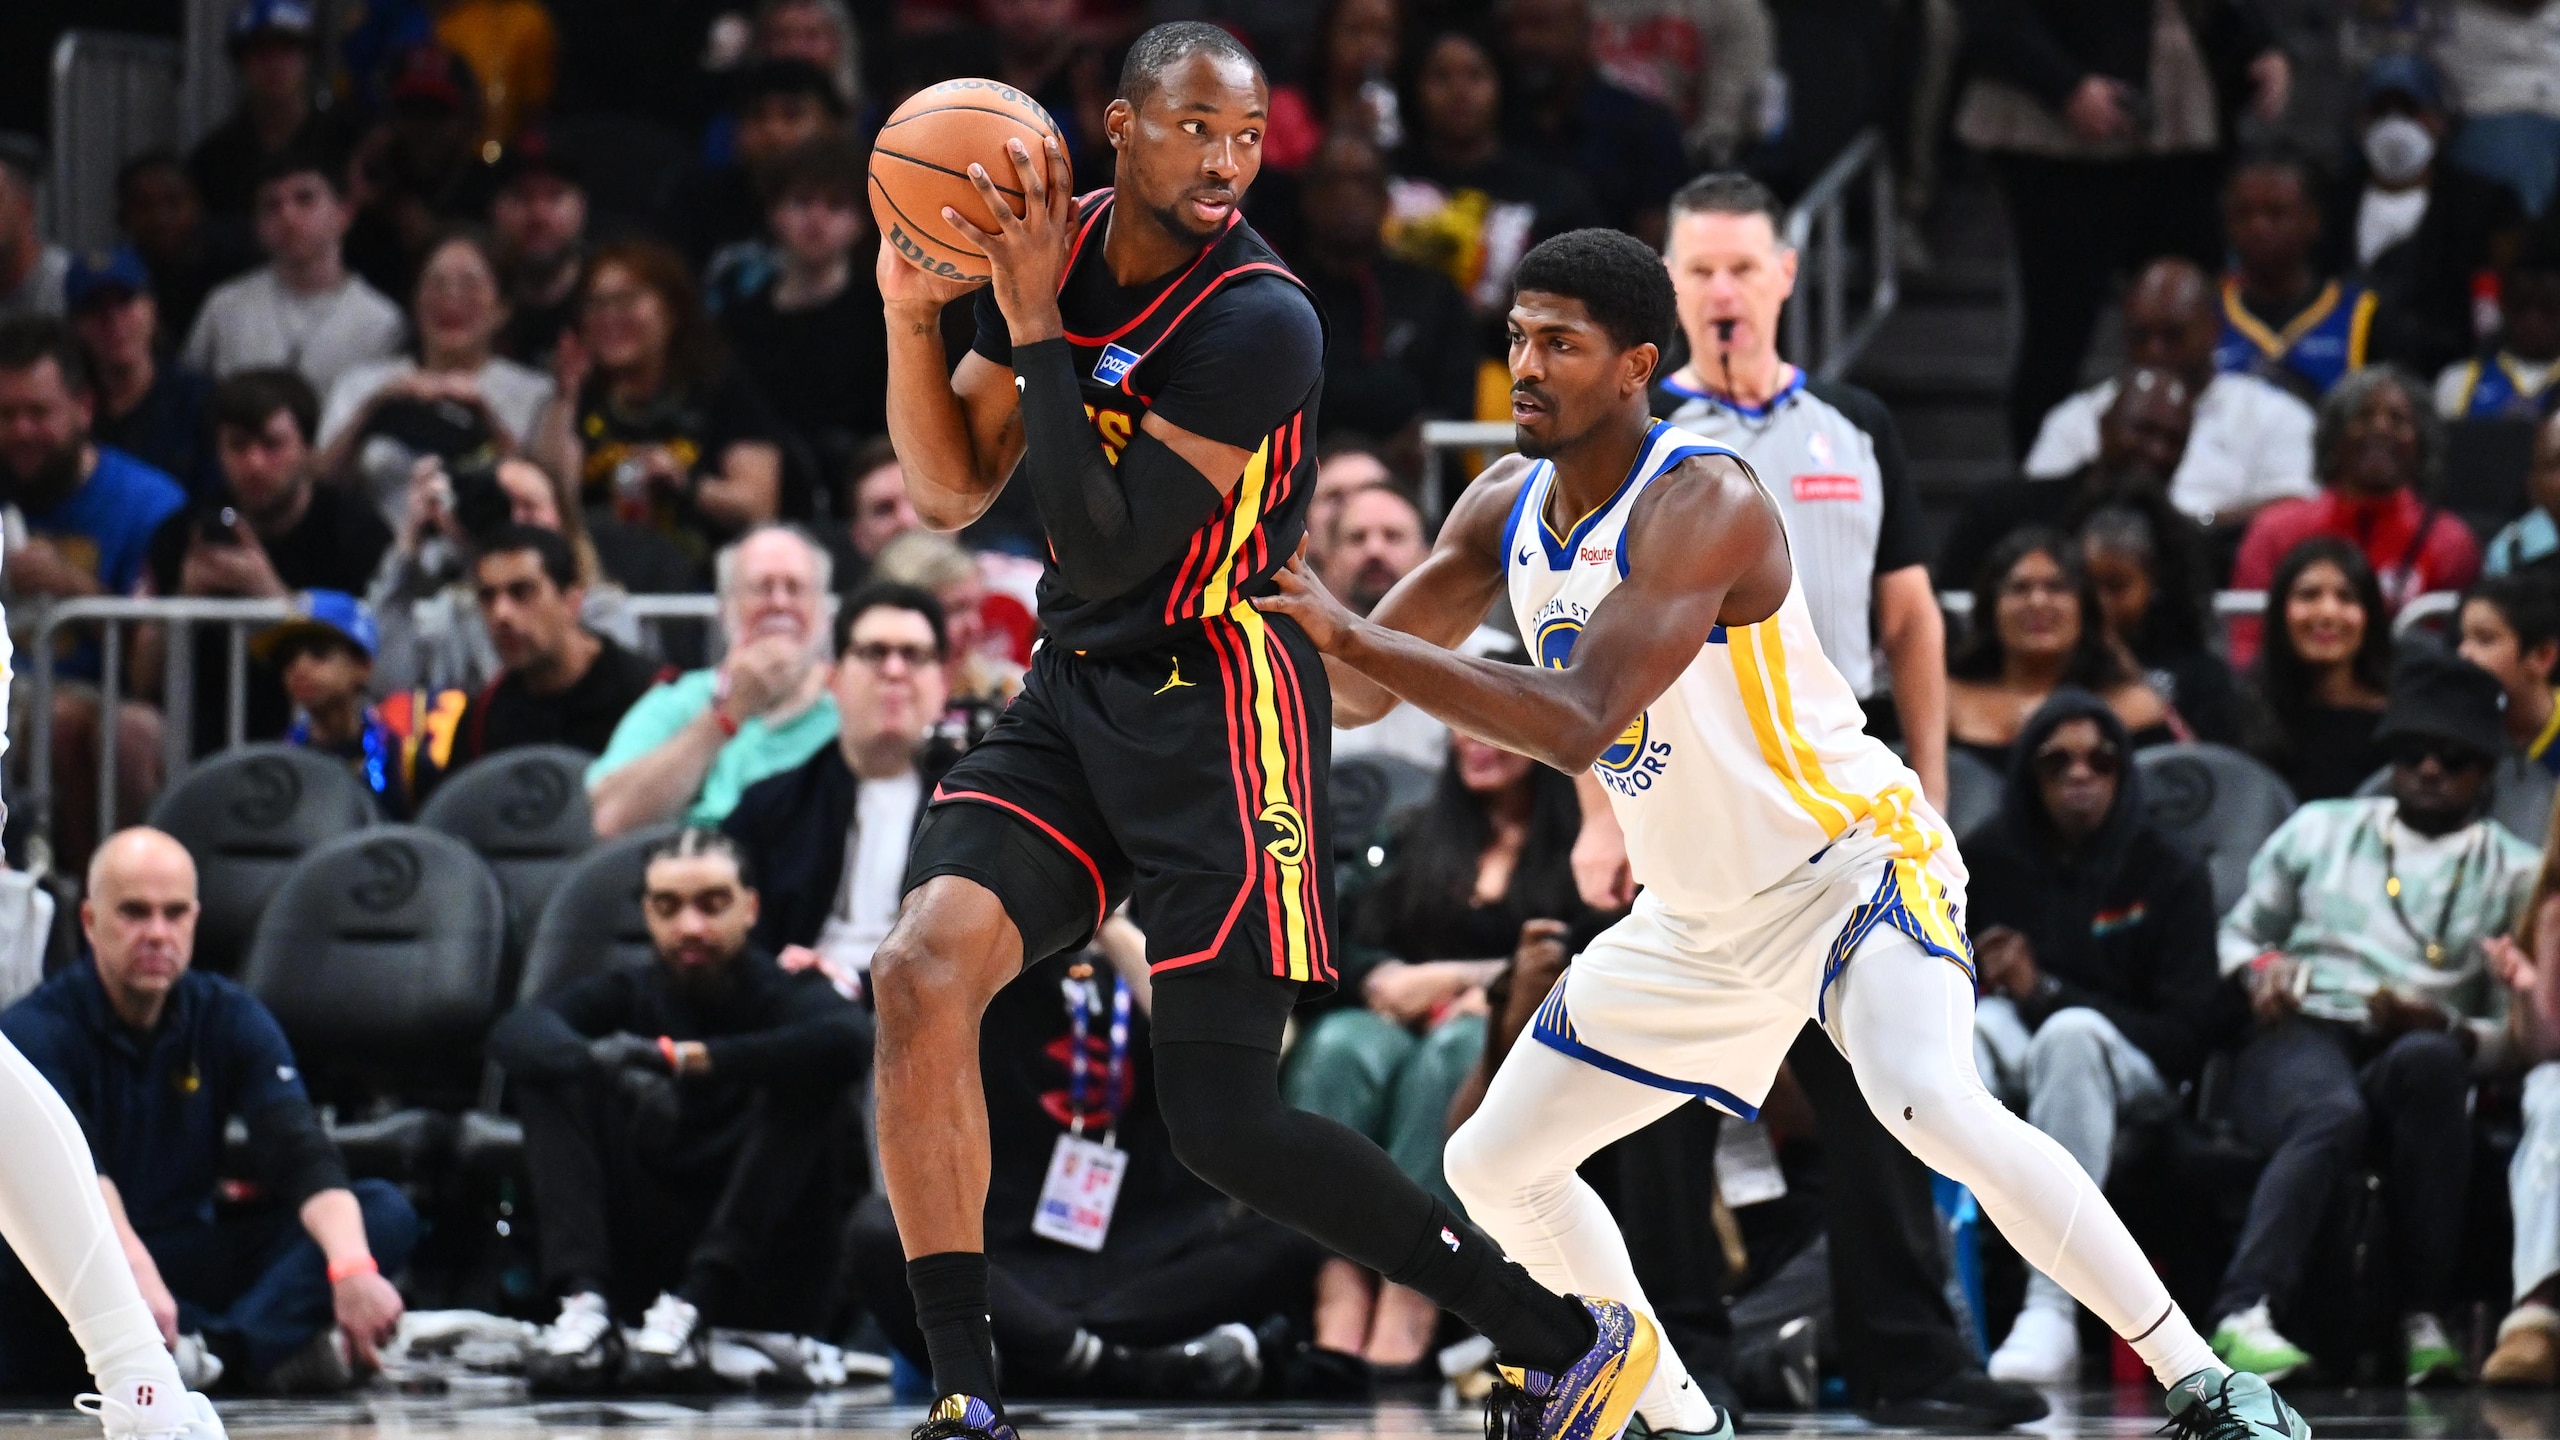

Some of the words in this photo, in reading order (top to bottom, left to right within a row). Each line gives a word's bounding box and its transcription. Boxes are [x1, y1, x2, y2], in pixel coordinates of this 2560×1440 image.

[889, 221, 992, 282] Wilso
[1580, 546, 1614, 561] Rakute
[1532, 598, 1565, 633] OLDEN
[1571, 601, 1589, 621] ST
